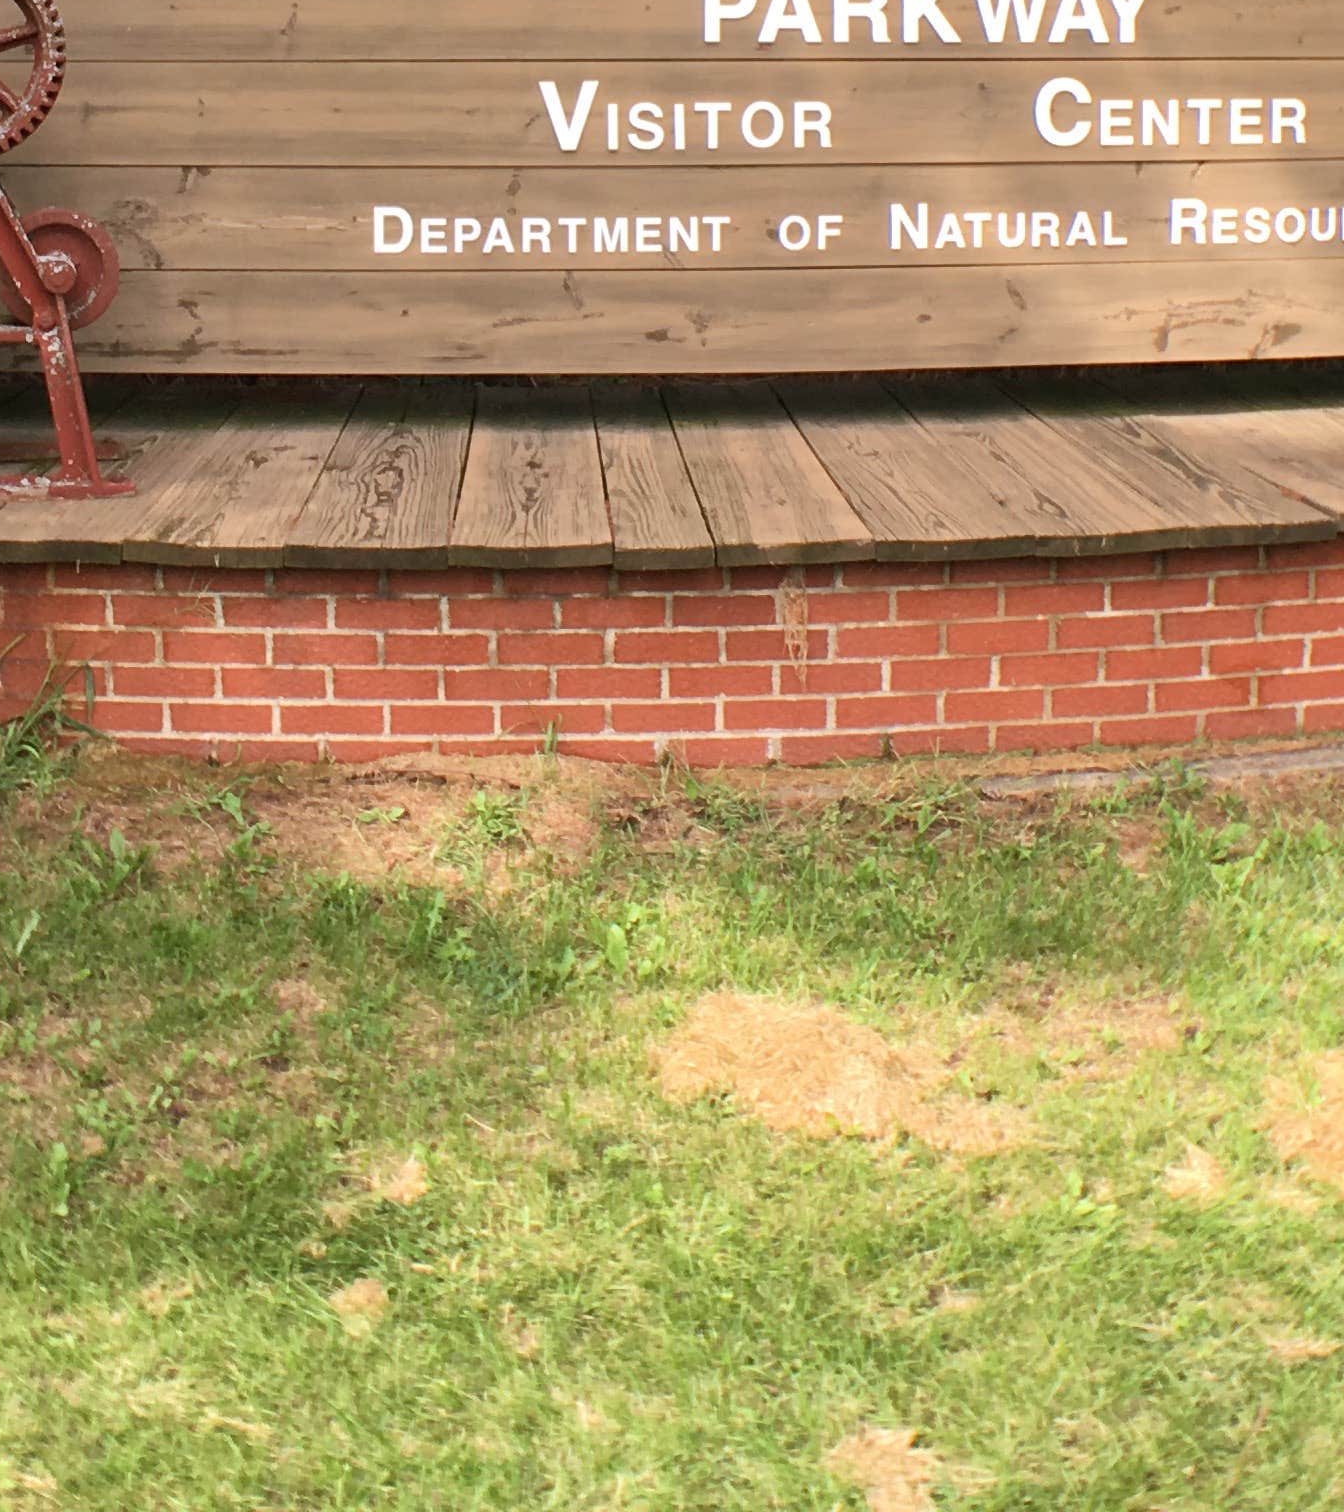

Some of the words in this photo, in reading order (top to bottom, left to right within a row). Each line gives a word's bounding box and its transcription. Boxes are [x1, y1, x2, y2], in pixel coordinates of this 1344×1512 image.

[538, 80, 832, 151] VISITOR
[1034, 76, 1306, 147] CENTER
[372, 205, 731, 254] DEPARTMENT
[778, 214, 843, 251] OF
[890, 202, 1128, 250] NATURAL
